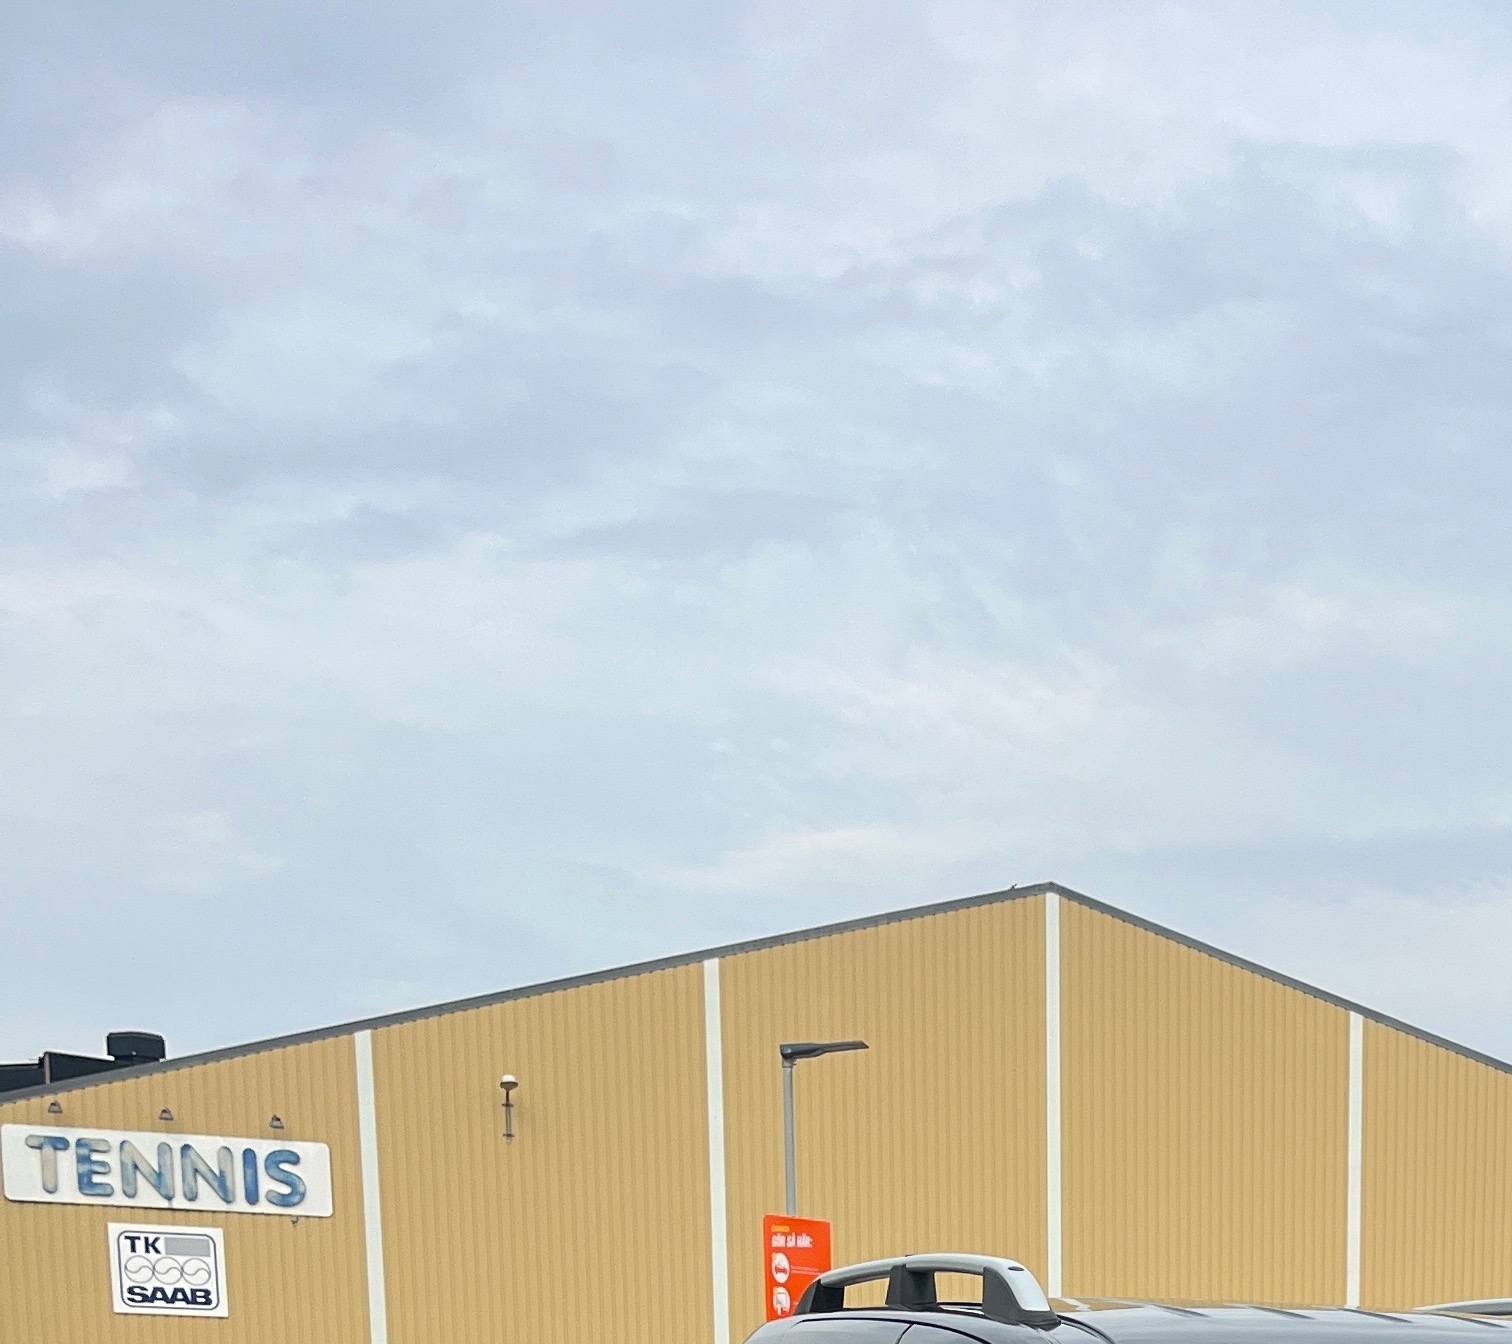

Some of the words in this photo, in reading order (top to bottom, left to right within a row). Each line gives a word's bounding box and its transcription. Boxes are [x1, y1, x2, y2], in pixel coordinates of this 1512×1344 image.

[25, 1134, 306, 1207] TENNIS
[124, 1235, 162, 1255] TK
[126, 1285, 213, 1306] SAAB
